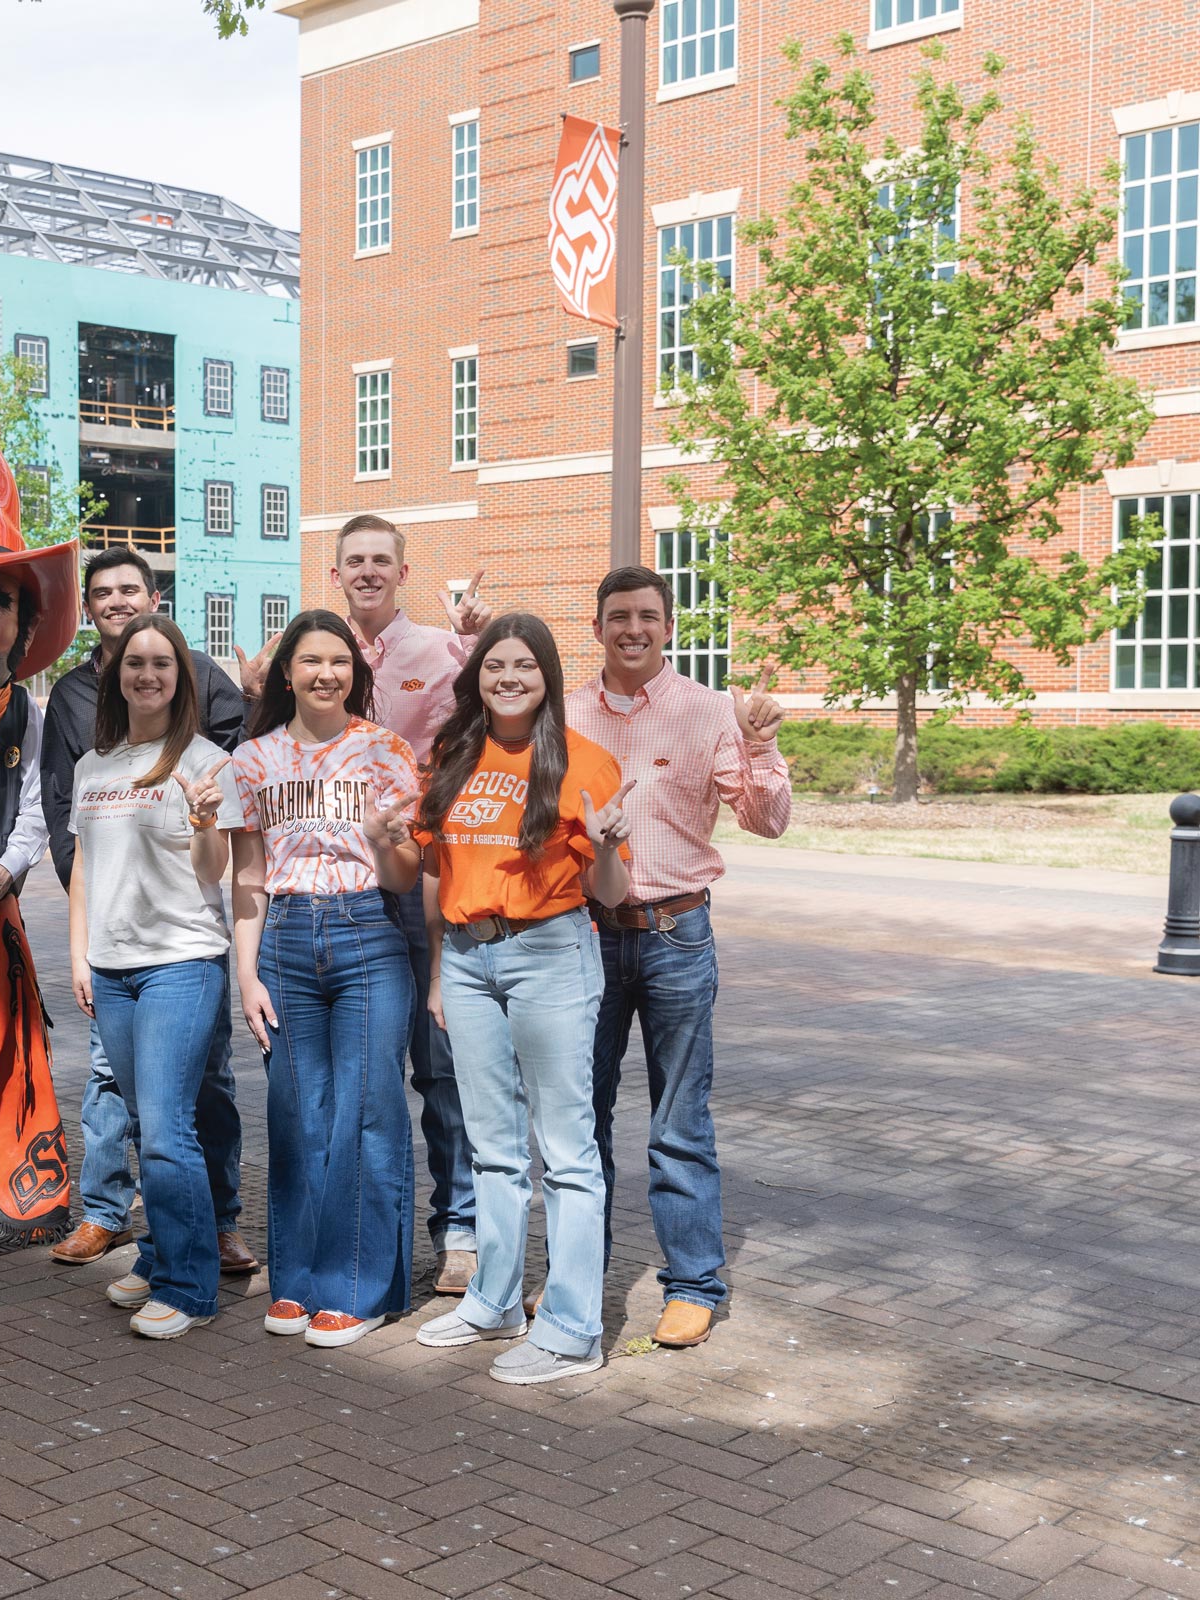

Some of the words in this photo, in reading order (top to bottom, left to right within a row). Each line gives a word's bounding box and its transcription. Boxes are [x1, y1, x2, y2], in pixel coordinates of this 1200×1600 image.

[549, 125, 618, 317] OSU
[400, 679, 426, 692] OSU
[334, 780, 369, 824] STAT
[448, 798, 506, 828] OSU
[281, 813, 352, 837] Cowboys
[460, 834, 471, 844] OF
